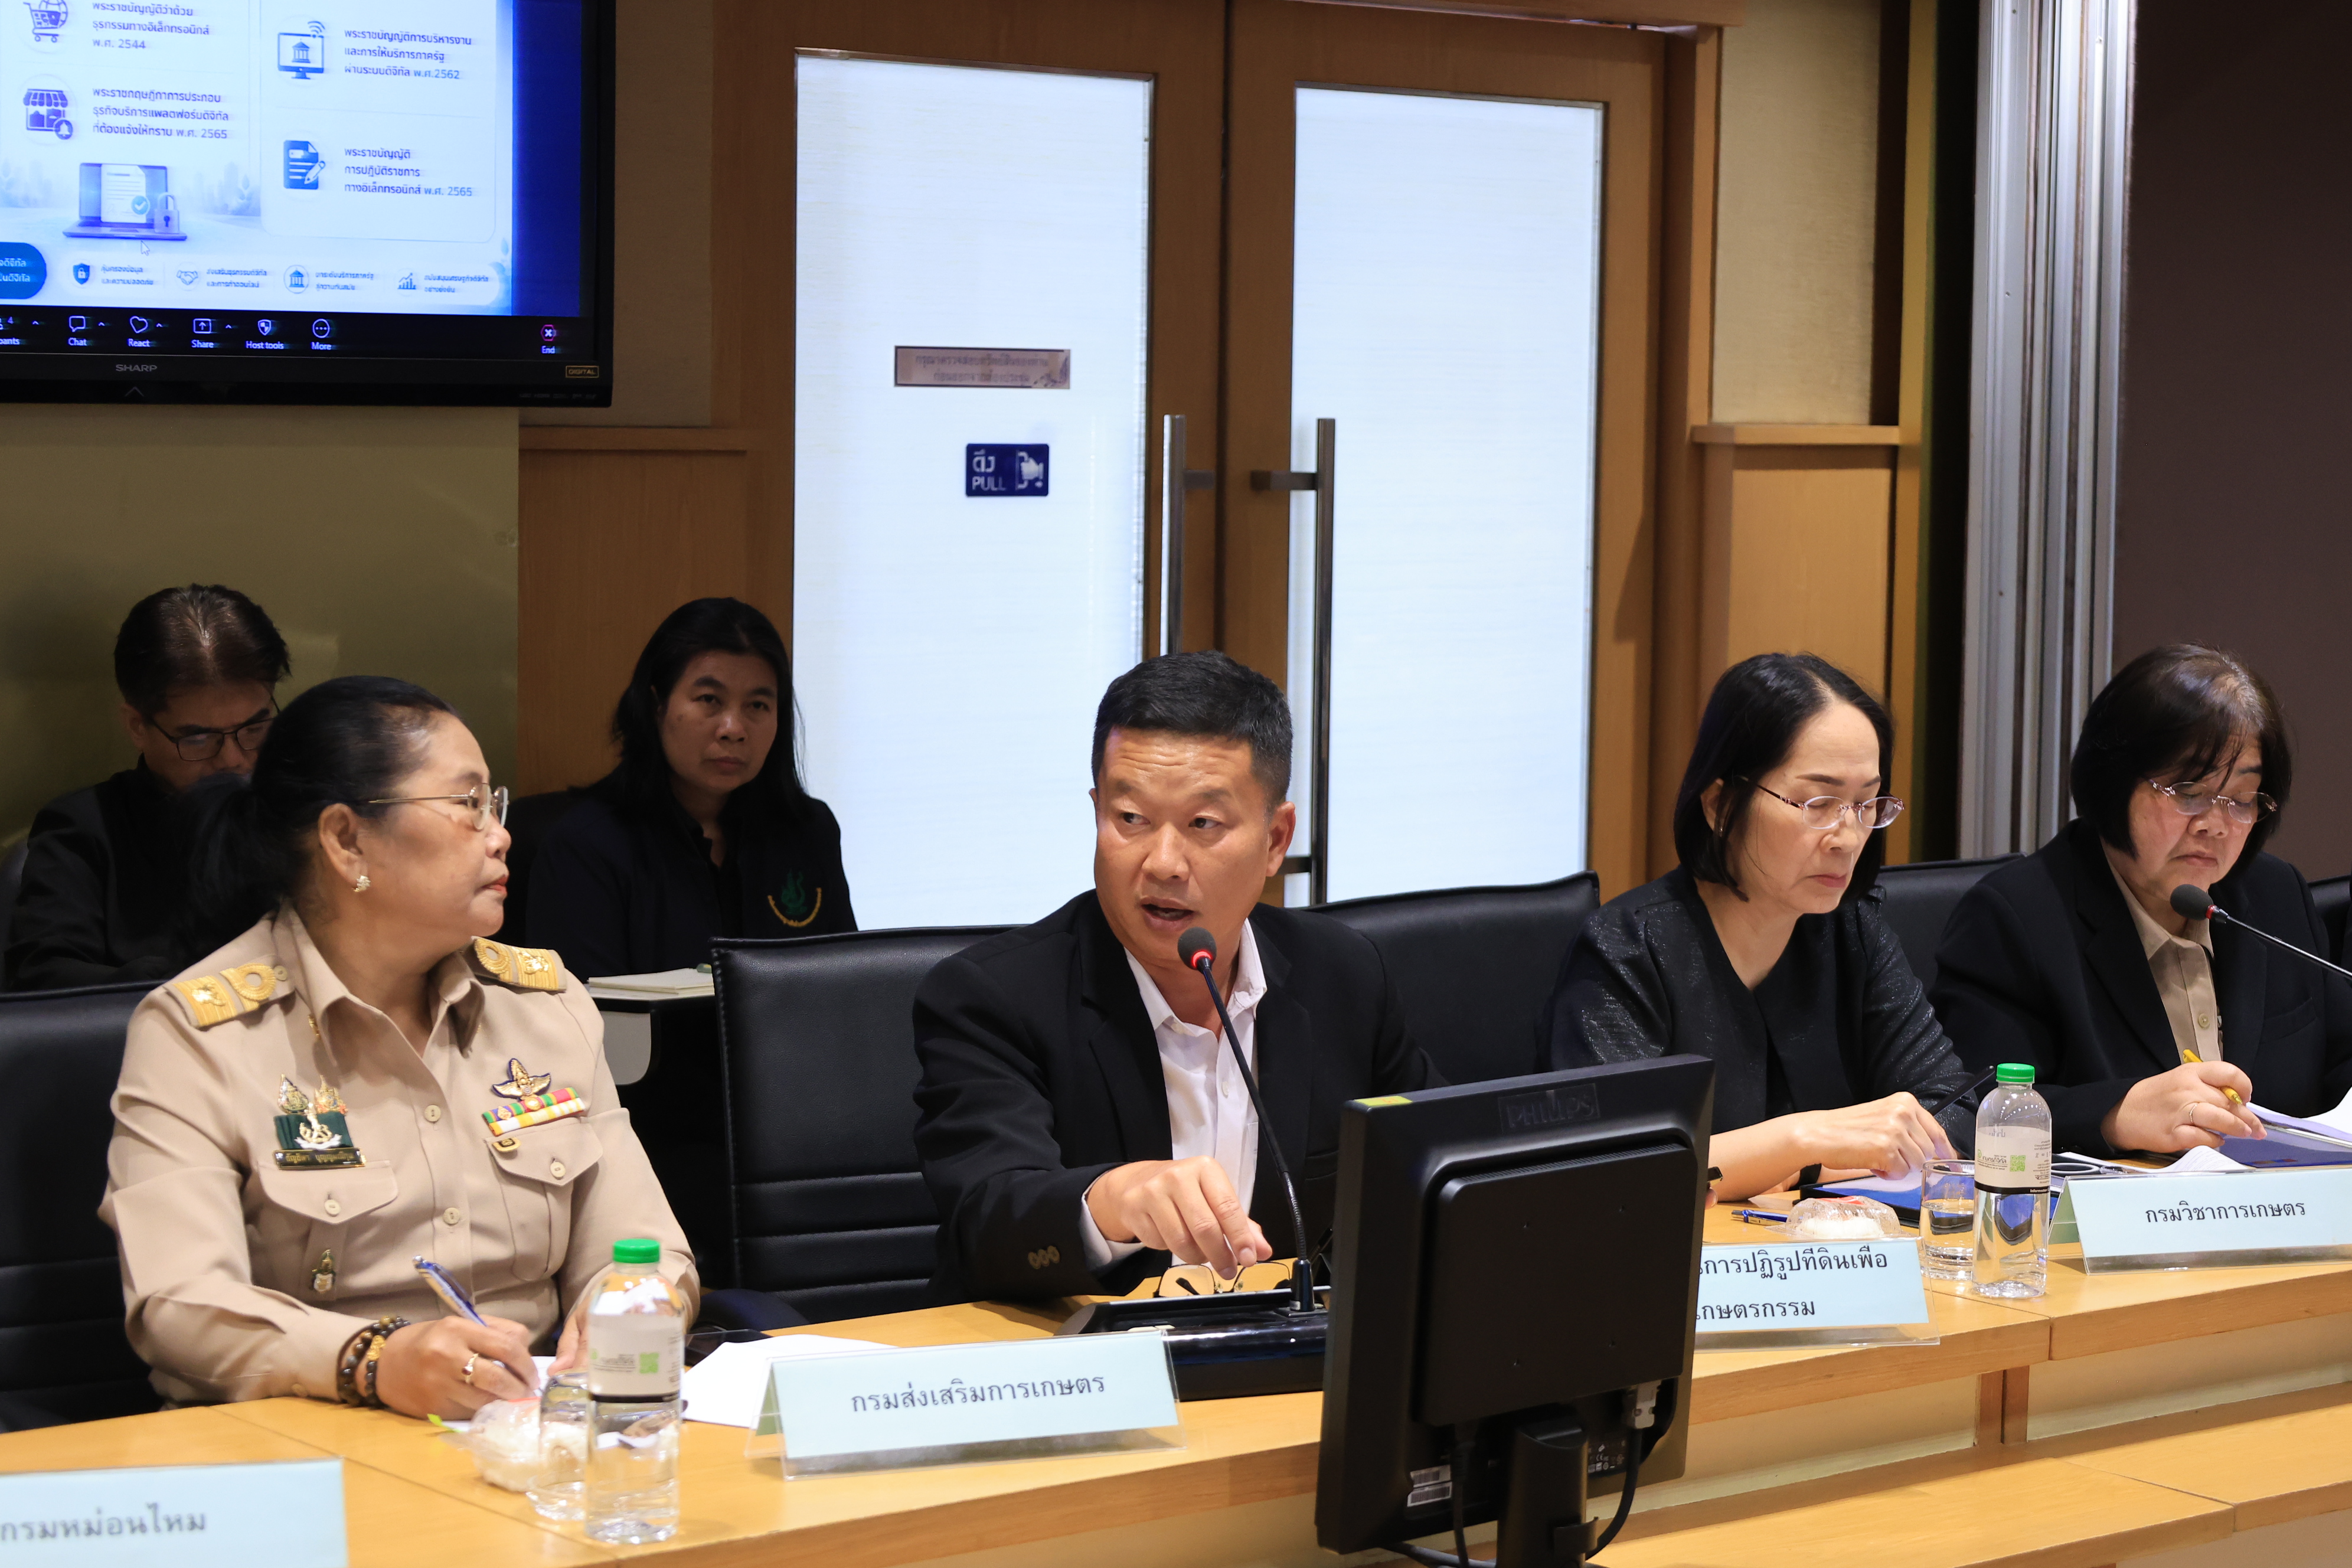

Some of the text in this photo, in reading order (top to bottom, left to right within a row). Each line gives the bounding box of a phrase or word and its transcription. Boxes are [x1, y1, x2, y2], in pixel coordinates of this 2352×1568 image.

[92, 2, 194, 16] พระราชบัญญัติว่าด้วย
[93, 38, 146, 49] พ.ศ. 2544
[344, 30, 472, 45] พระราชบัญญัติการบริหารงาน
[345, 46, 445, 63] และการให้บริการภาครัฐ
[413, 69, 460, 80] พ.ศ.2562
[176, 128, 197, 138] พ.ศ.
[201, 128, 228, 139] 2565
[345, 148, 411, 161] พระราชบัญญัติ
[345, 165, 421, 177] การปฏิบัติราชการ
[345, 181, 472, 197] ทางอิเล็กทรอนิกส์ พ.ศ. 2565
[68, 338, 87, 346] Chat
[128, 338, 151, 347] React
[191, 339, 214, 348] Share
[246, 341, 284, 349] Host tools
[311, 342, 332, 350] More
[541, 345, 555, 354] End
[972, 449, 996, 473] ดึง
[972, 476, 1007, 491] PULL
[2145, 1200, 2306, 1223] กรมวิชาการเกษตร
[851, 1375, 1105, 1412] กรมส่งเสริมการเกษตร
[1, 1502, 207, 1541] กรมหม่อนไหม
